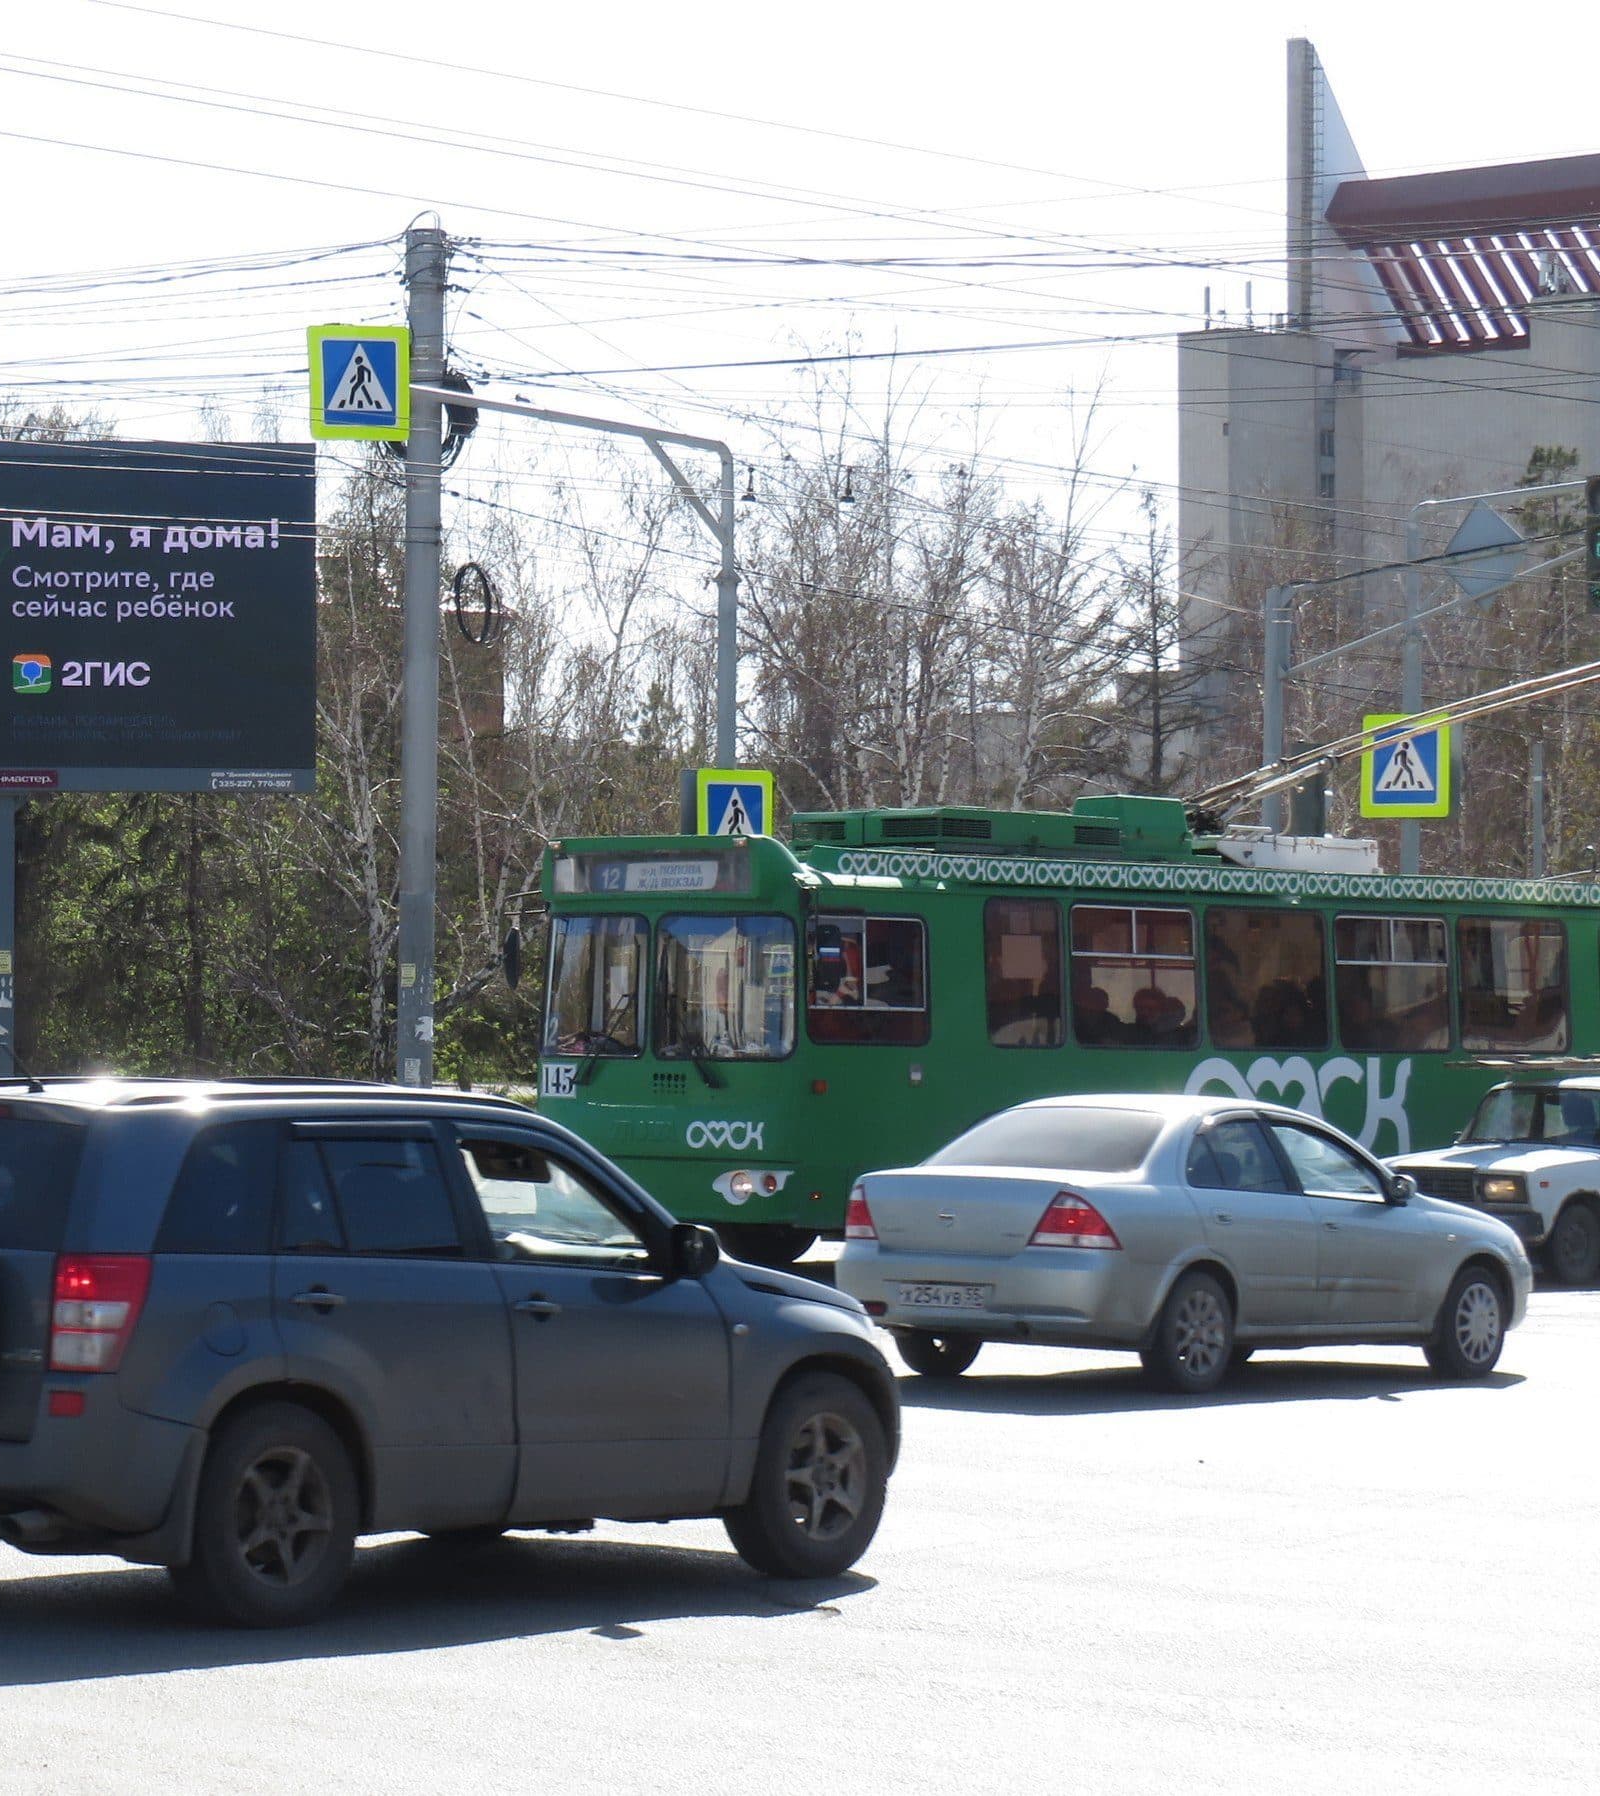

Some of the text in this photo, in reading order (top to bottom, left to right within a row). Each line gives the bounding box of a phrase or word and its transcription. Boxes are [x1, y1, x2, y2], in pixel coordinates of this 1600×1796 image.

[12, 517, 115, 554] Мам,
[129, 525, 152, 549] я
[163, 517, 280, 553] дома!
[12, 565, 215, 592] Смотрите, где
[12, 594, 236, 622] сейчас ребёнок
[61, 661, 152, 687] 2ГИС
[601, 866, 620, 890] 12
[543, 1066, 575, 1095] 145
[685, 1120, 764, 1150] ОМСК
